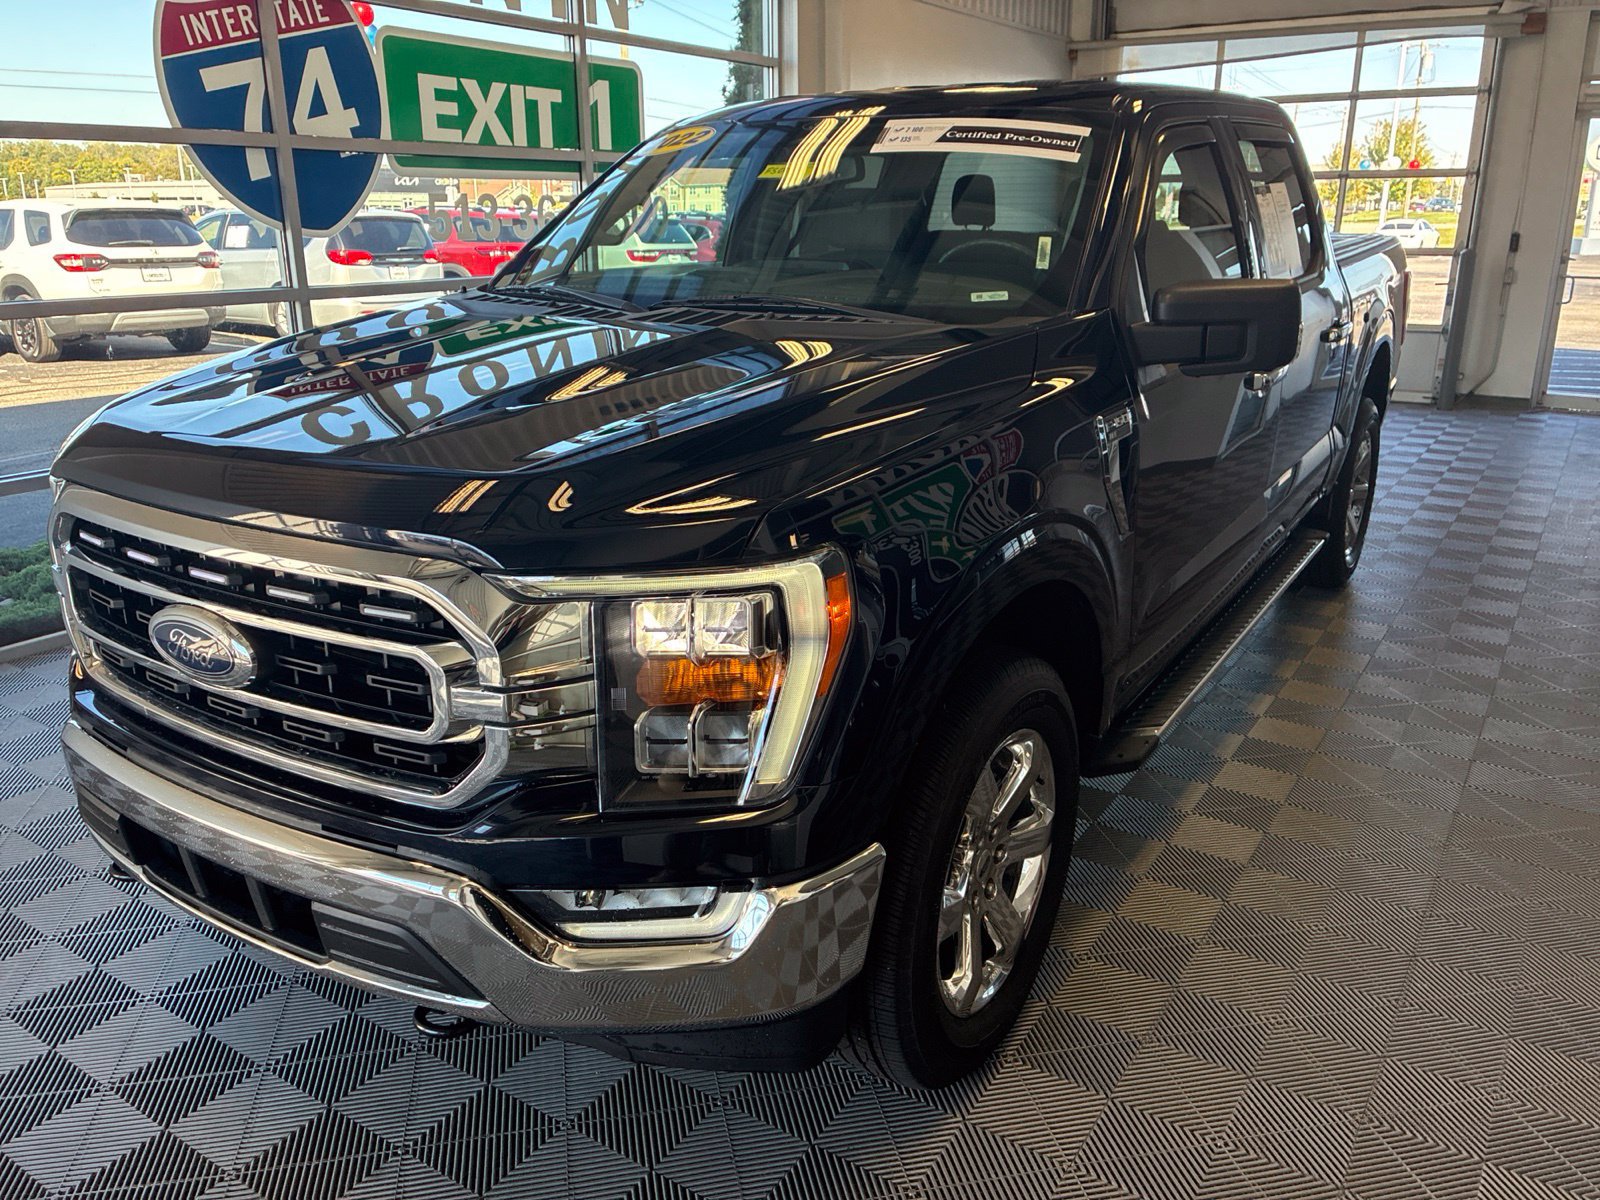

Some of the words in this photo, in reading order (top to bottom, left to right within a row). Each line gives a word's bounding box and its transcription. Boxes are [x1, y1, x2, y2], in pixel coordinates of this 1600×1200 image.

[179, 0, 330, 46] INTERTATE
[199, 46, 360, 181] 74
[417, 72, 562, 149] EXIT
[588, 79, 612, 151] 1
[945, 129, 1001, 140] Certified
[1004, 133, 1077, 148] Pre-Owned
[167, 628, 215, 669] Ford
